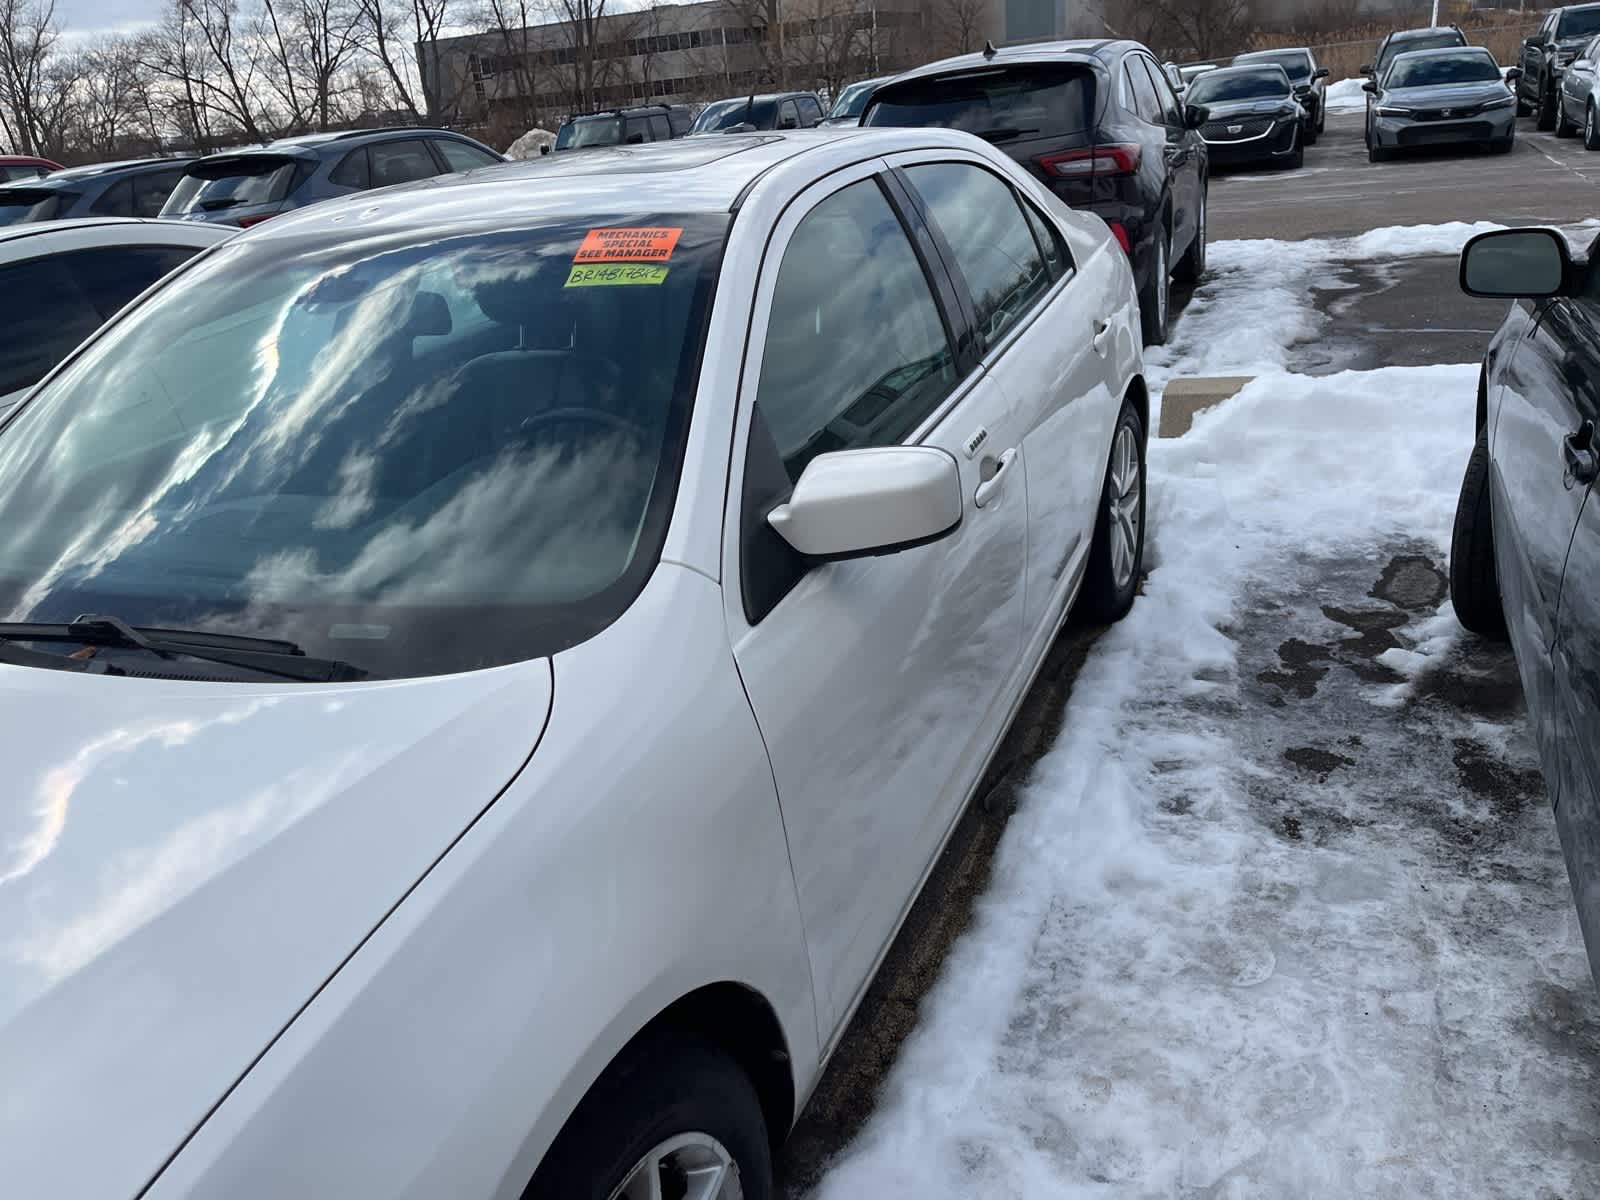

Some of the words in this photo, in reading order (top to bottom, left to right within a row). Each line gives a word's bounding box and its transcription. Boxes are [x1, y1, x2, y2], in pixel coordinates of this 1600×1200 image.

[597, 231, 668, 239] MECHANICS
[603, 240, 653, 248] SPECIAL
[579, 249, 602, 258] SEE
[604, 248, 668, 257] MANAGER
